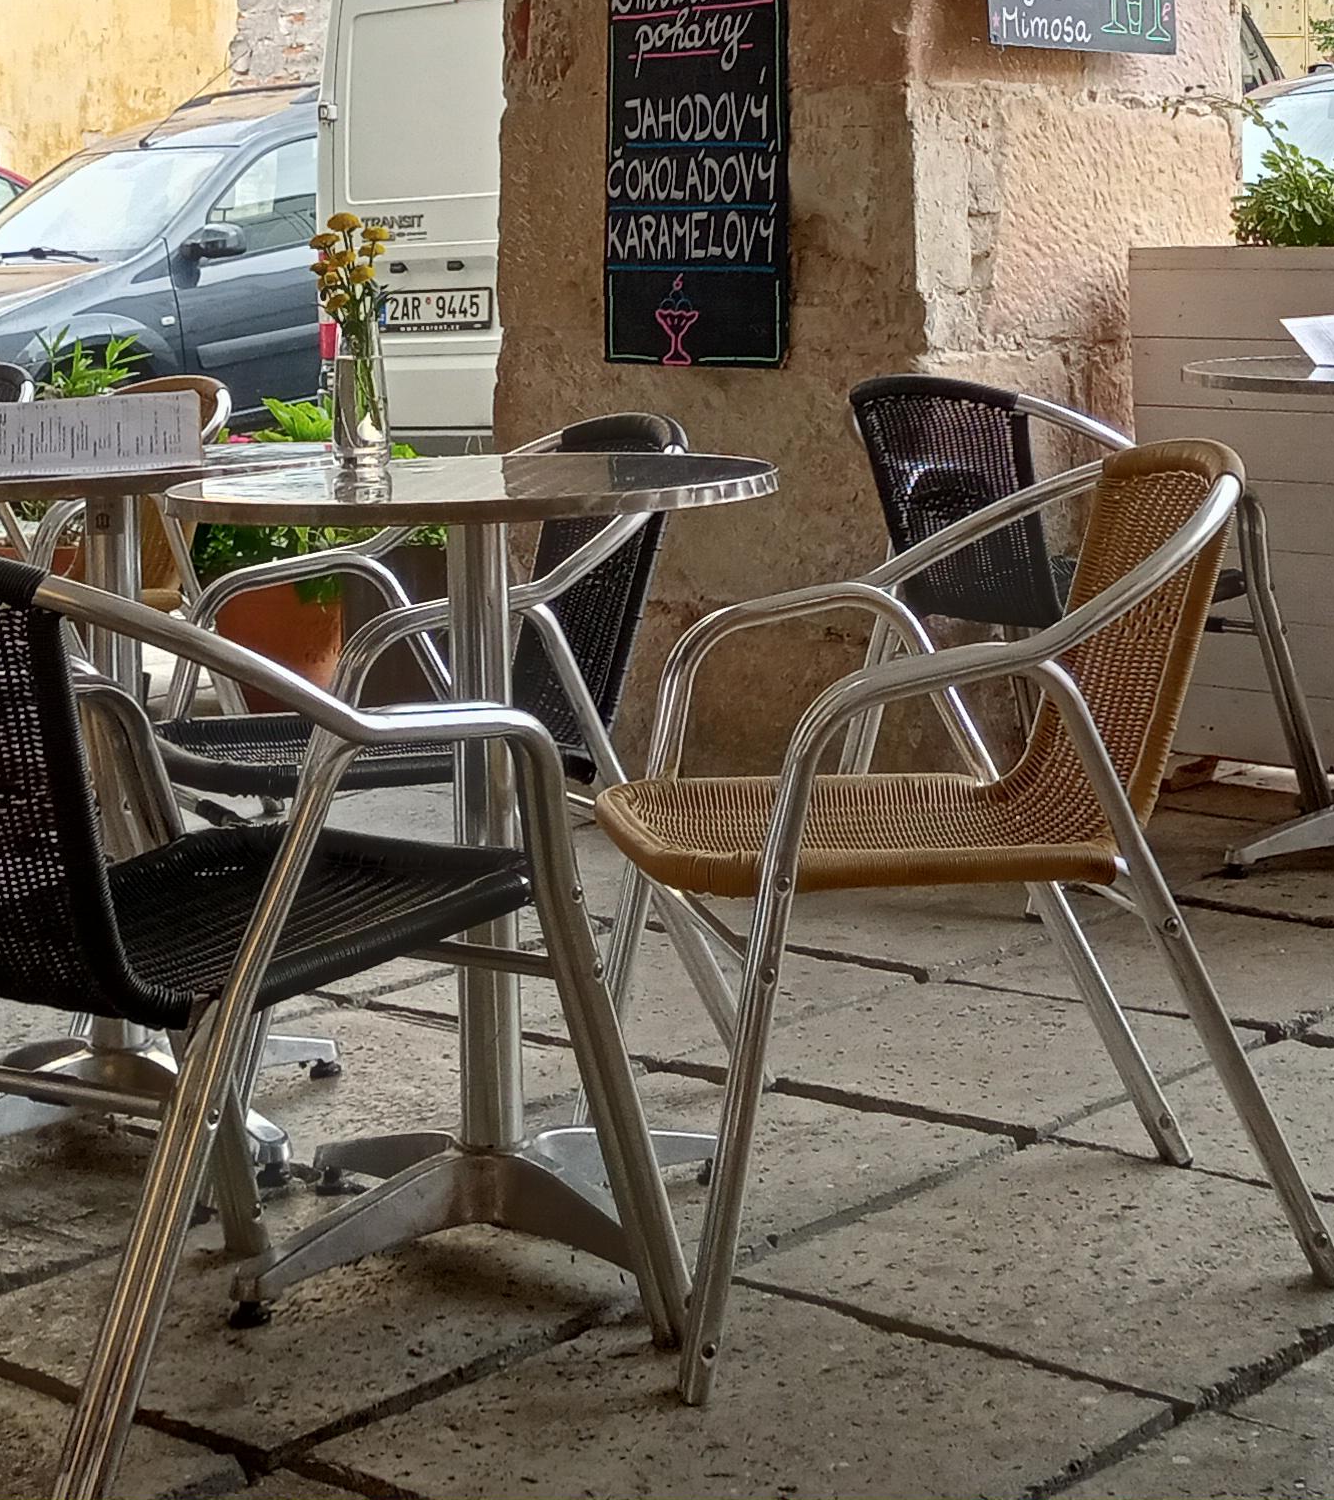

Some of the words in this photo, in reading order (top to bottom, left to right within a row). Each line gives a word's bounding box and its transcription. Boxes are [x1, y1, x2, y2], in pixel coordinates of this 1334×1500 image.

[1002, 6, 1092, 44] Mimosa
[390, 296, 422, 321] 2AR
[436, 294, 480, 319] 9445
